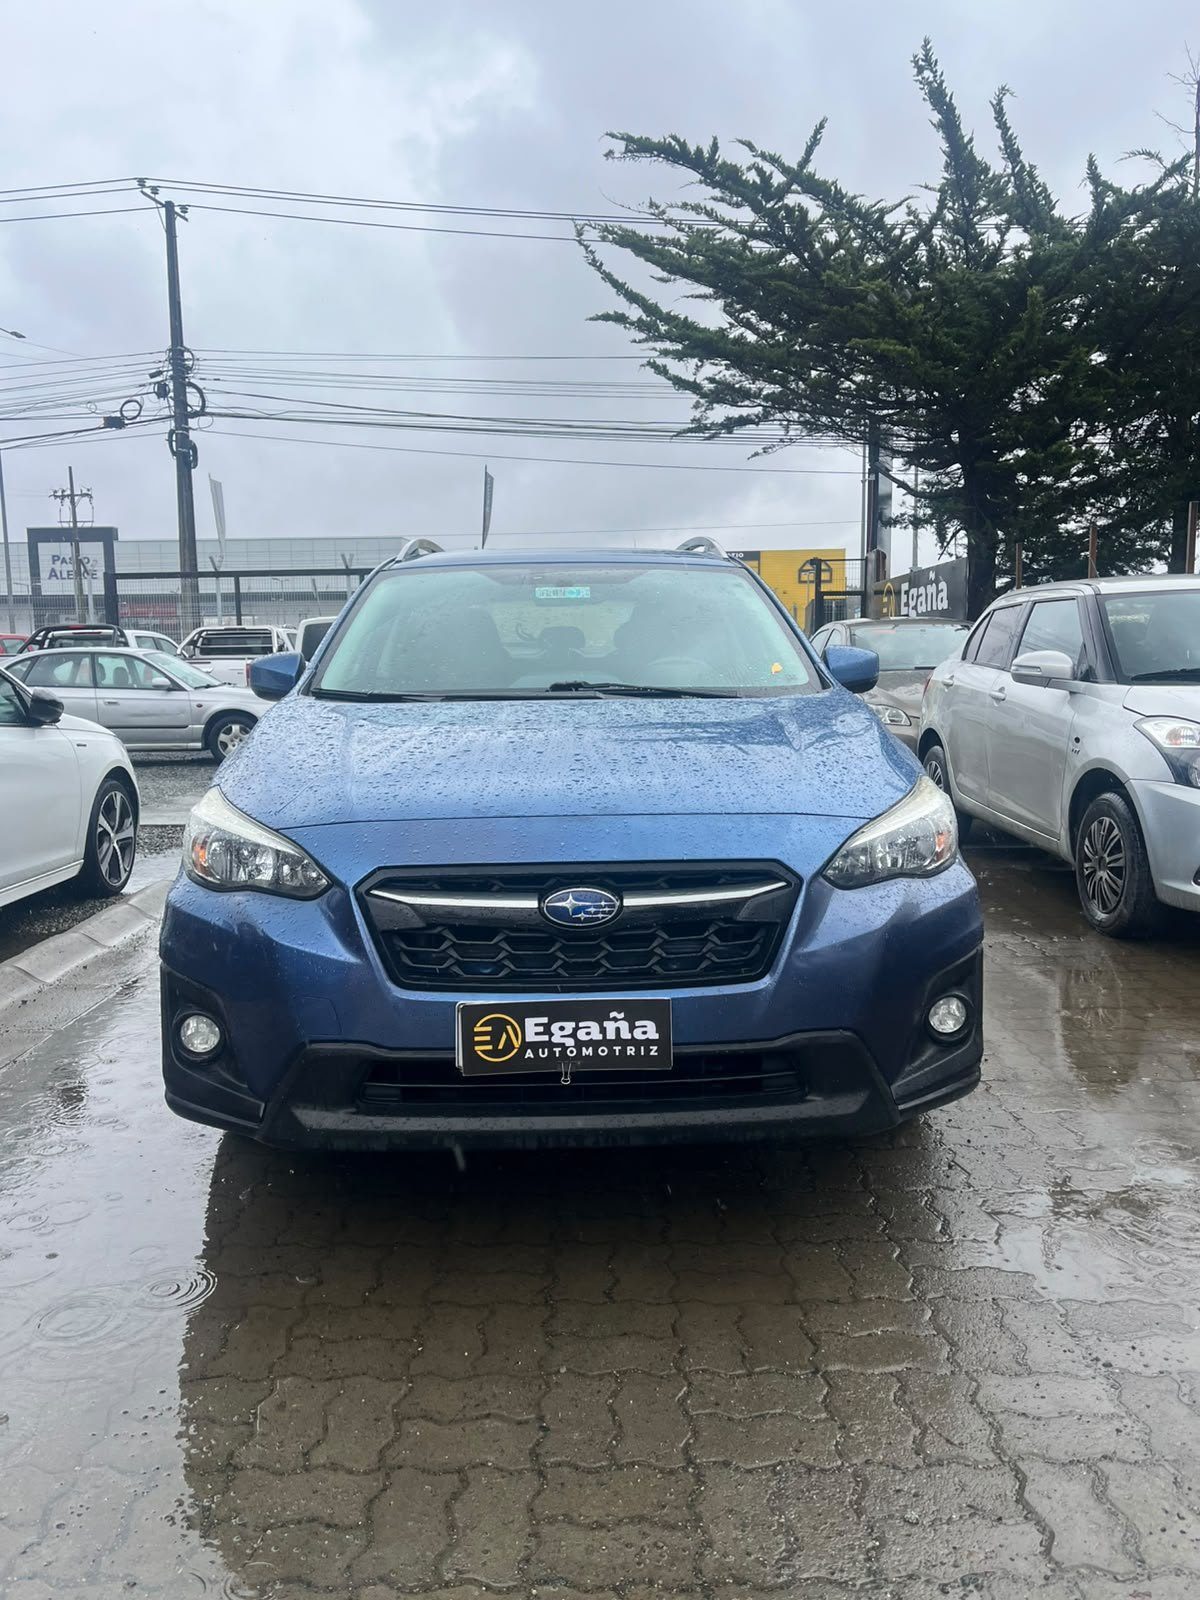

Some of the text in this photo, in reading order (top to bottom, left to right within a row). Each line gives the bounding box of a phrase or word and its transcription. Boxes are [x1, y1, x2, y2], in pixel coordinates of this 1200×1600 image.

[900, 570, 949, 617] Egaña
[524, 1011, 659, 1046] Egaña
[524, 1046, 659, 1058] AUTOMOTRIZ
